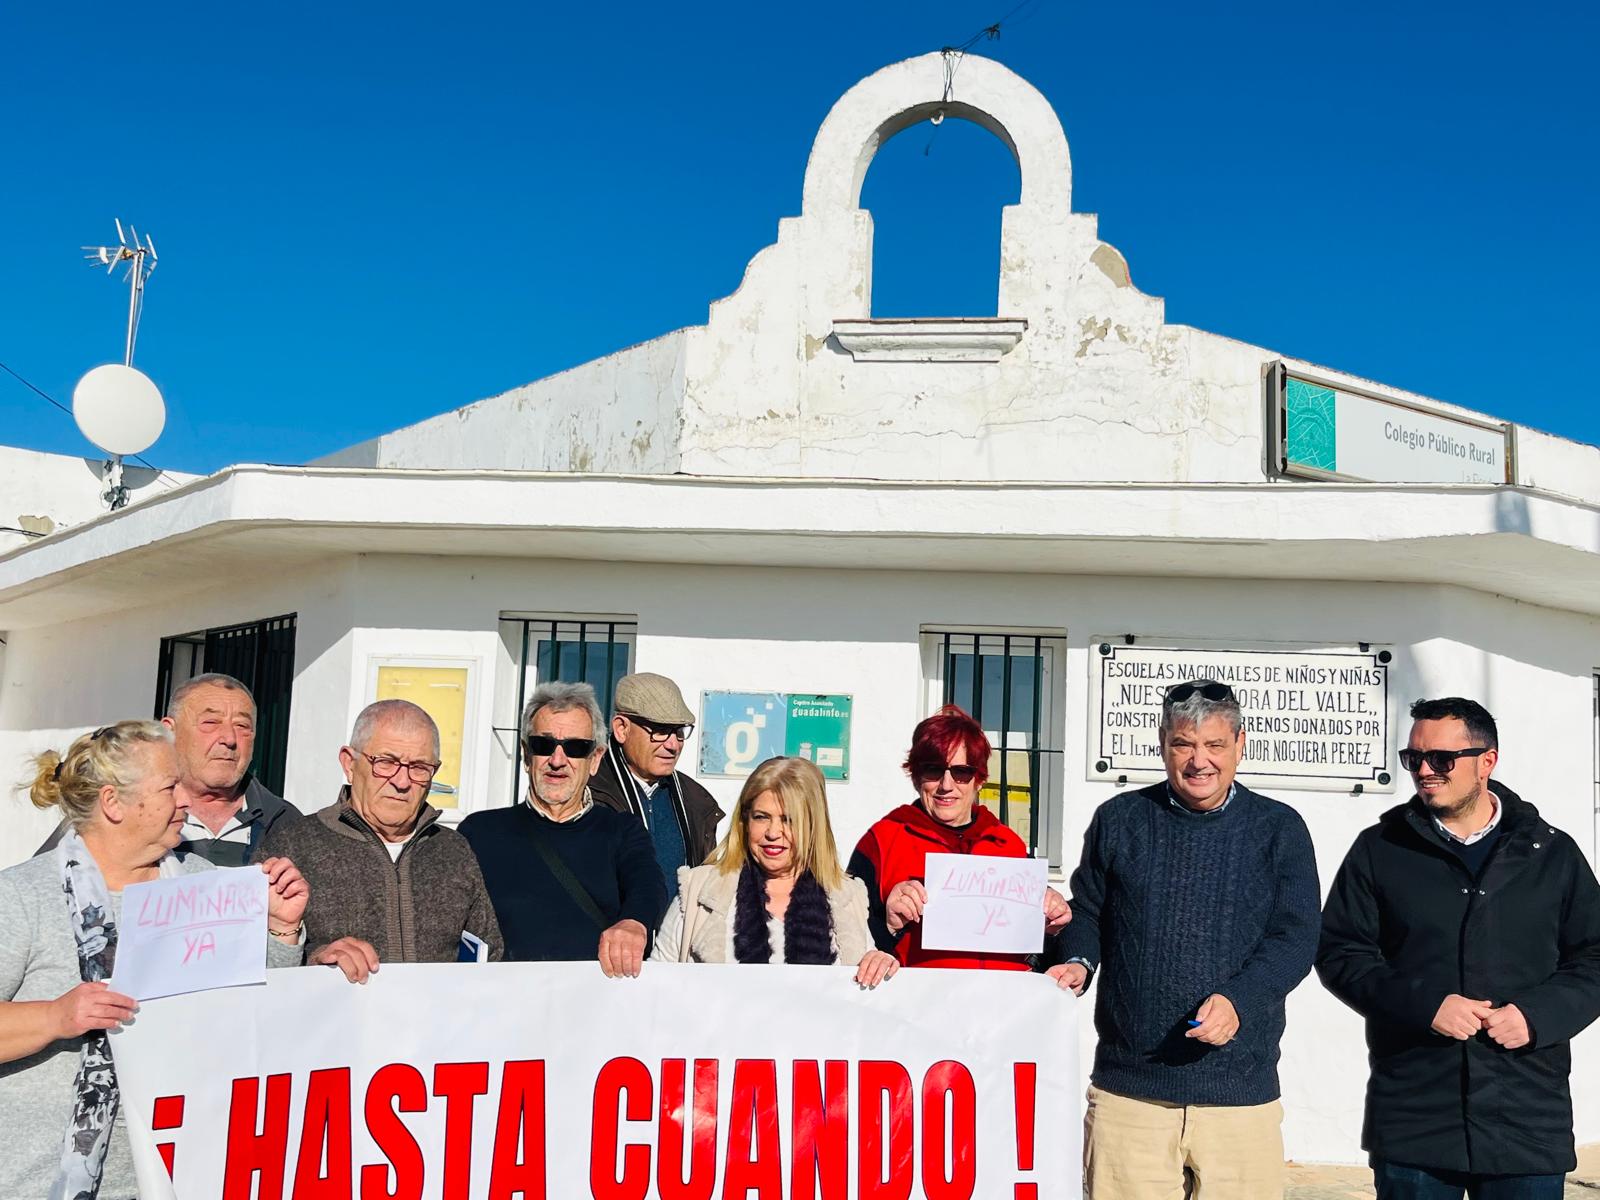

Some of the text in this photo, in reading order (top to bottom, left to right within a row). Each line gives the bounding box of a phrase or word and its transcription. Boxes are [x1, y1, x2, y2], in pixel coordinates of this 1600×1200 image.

[1384, 421, 1495, 465] Colegio Público Rural
[1108, 662, 1382, 686] ESCUELAS NACIONALES DE NIÑOS Y NIÑAS
[1277, 689, 1310, 711] DEL
[1241, 716, 1290, 733] RRENOS
[1294, 718, 1352, 735] DONADOS
[1356, 720, 1380, 737] POR
[1112, 733, 1126, 756] EL
[1241, 739, 1270, 761] ADOR
[1273, 739, 1328, 764] NOGUERA
[1331, 742, 1371, 765] PEREZ
[181, 930, 216, 965] YA
[222, 1059, 546, 1200] HASTA
[589, 1056, 977, 1200] CUANDO
